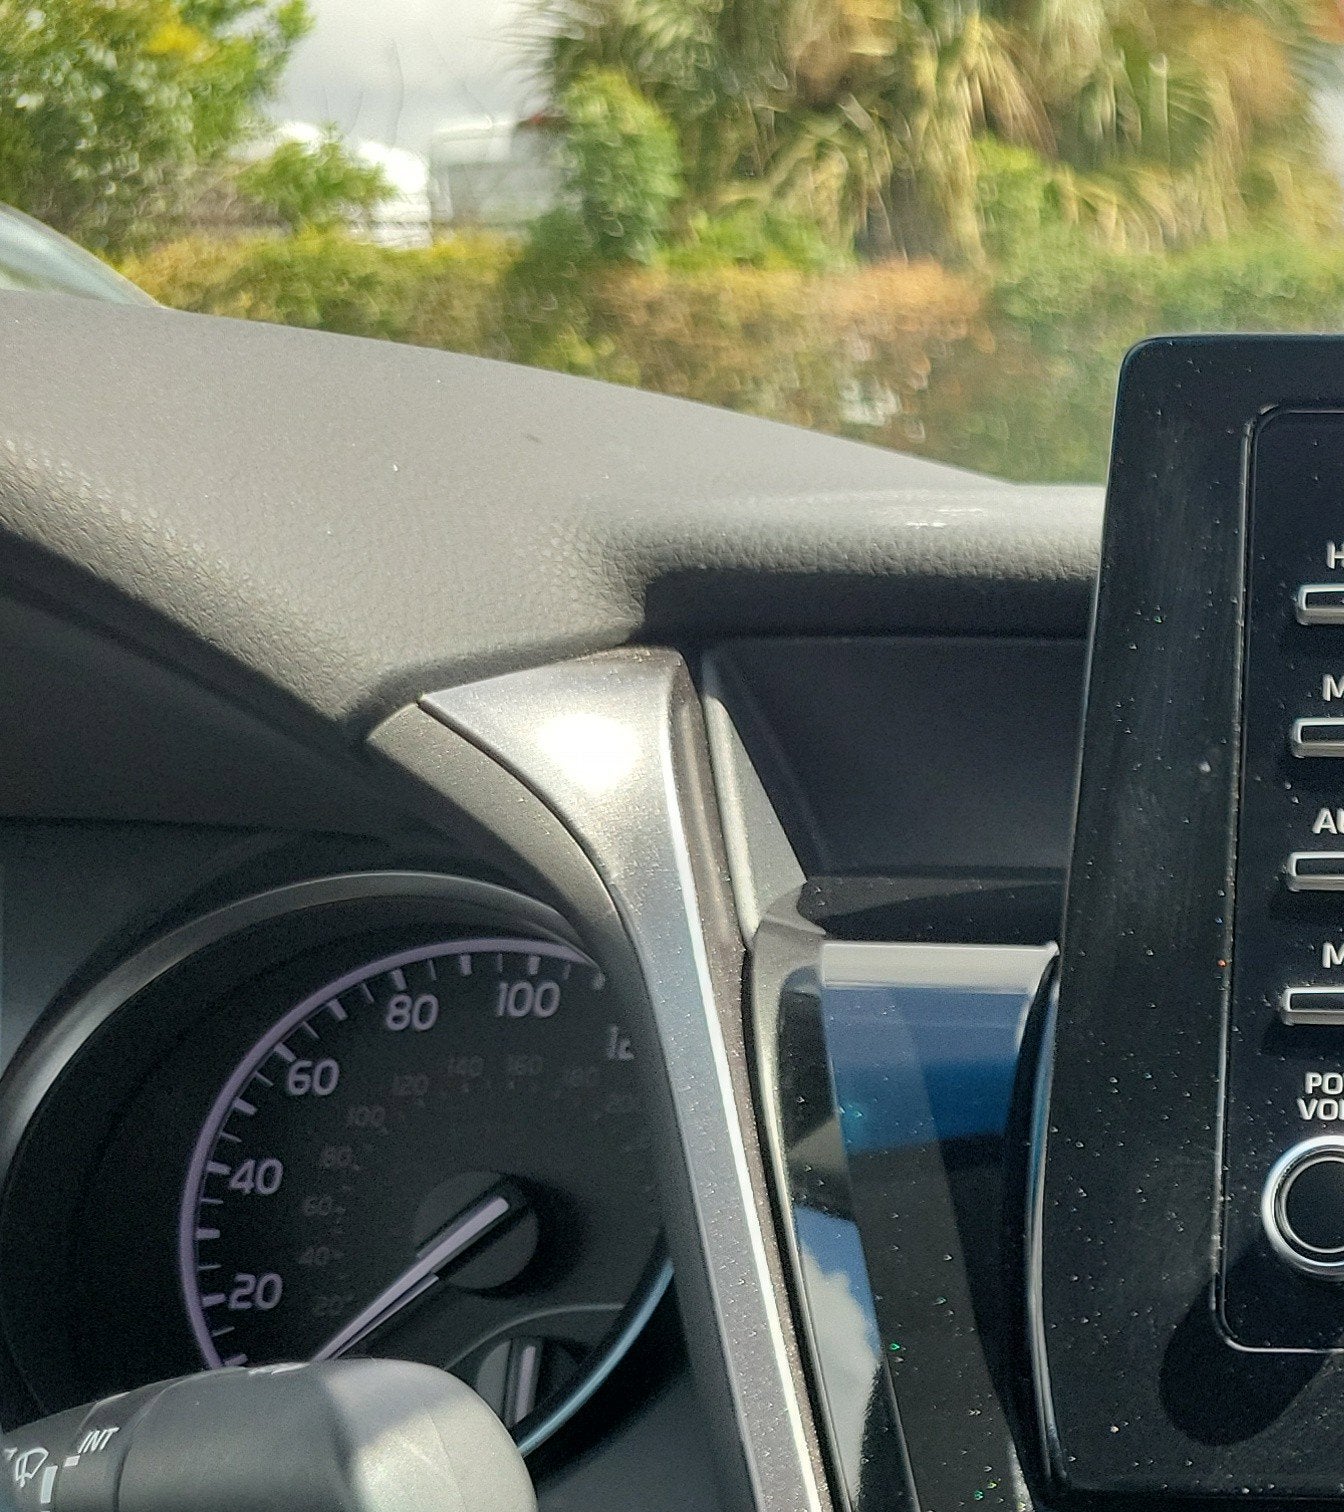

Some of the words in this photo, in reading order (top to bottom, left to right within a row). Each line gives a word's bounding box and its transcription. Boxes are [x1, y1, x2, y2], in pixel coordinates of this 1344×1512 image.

[383, 993, 440, 1032] 80
[495, 980, 561, 1018] 100
[285, 1058, 340, 1097] 60
[229, 1157, 284, 1196] 40
[228, 1272, 283, 1311] 20
[77, 1427, 118, 1454] INT
